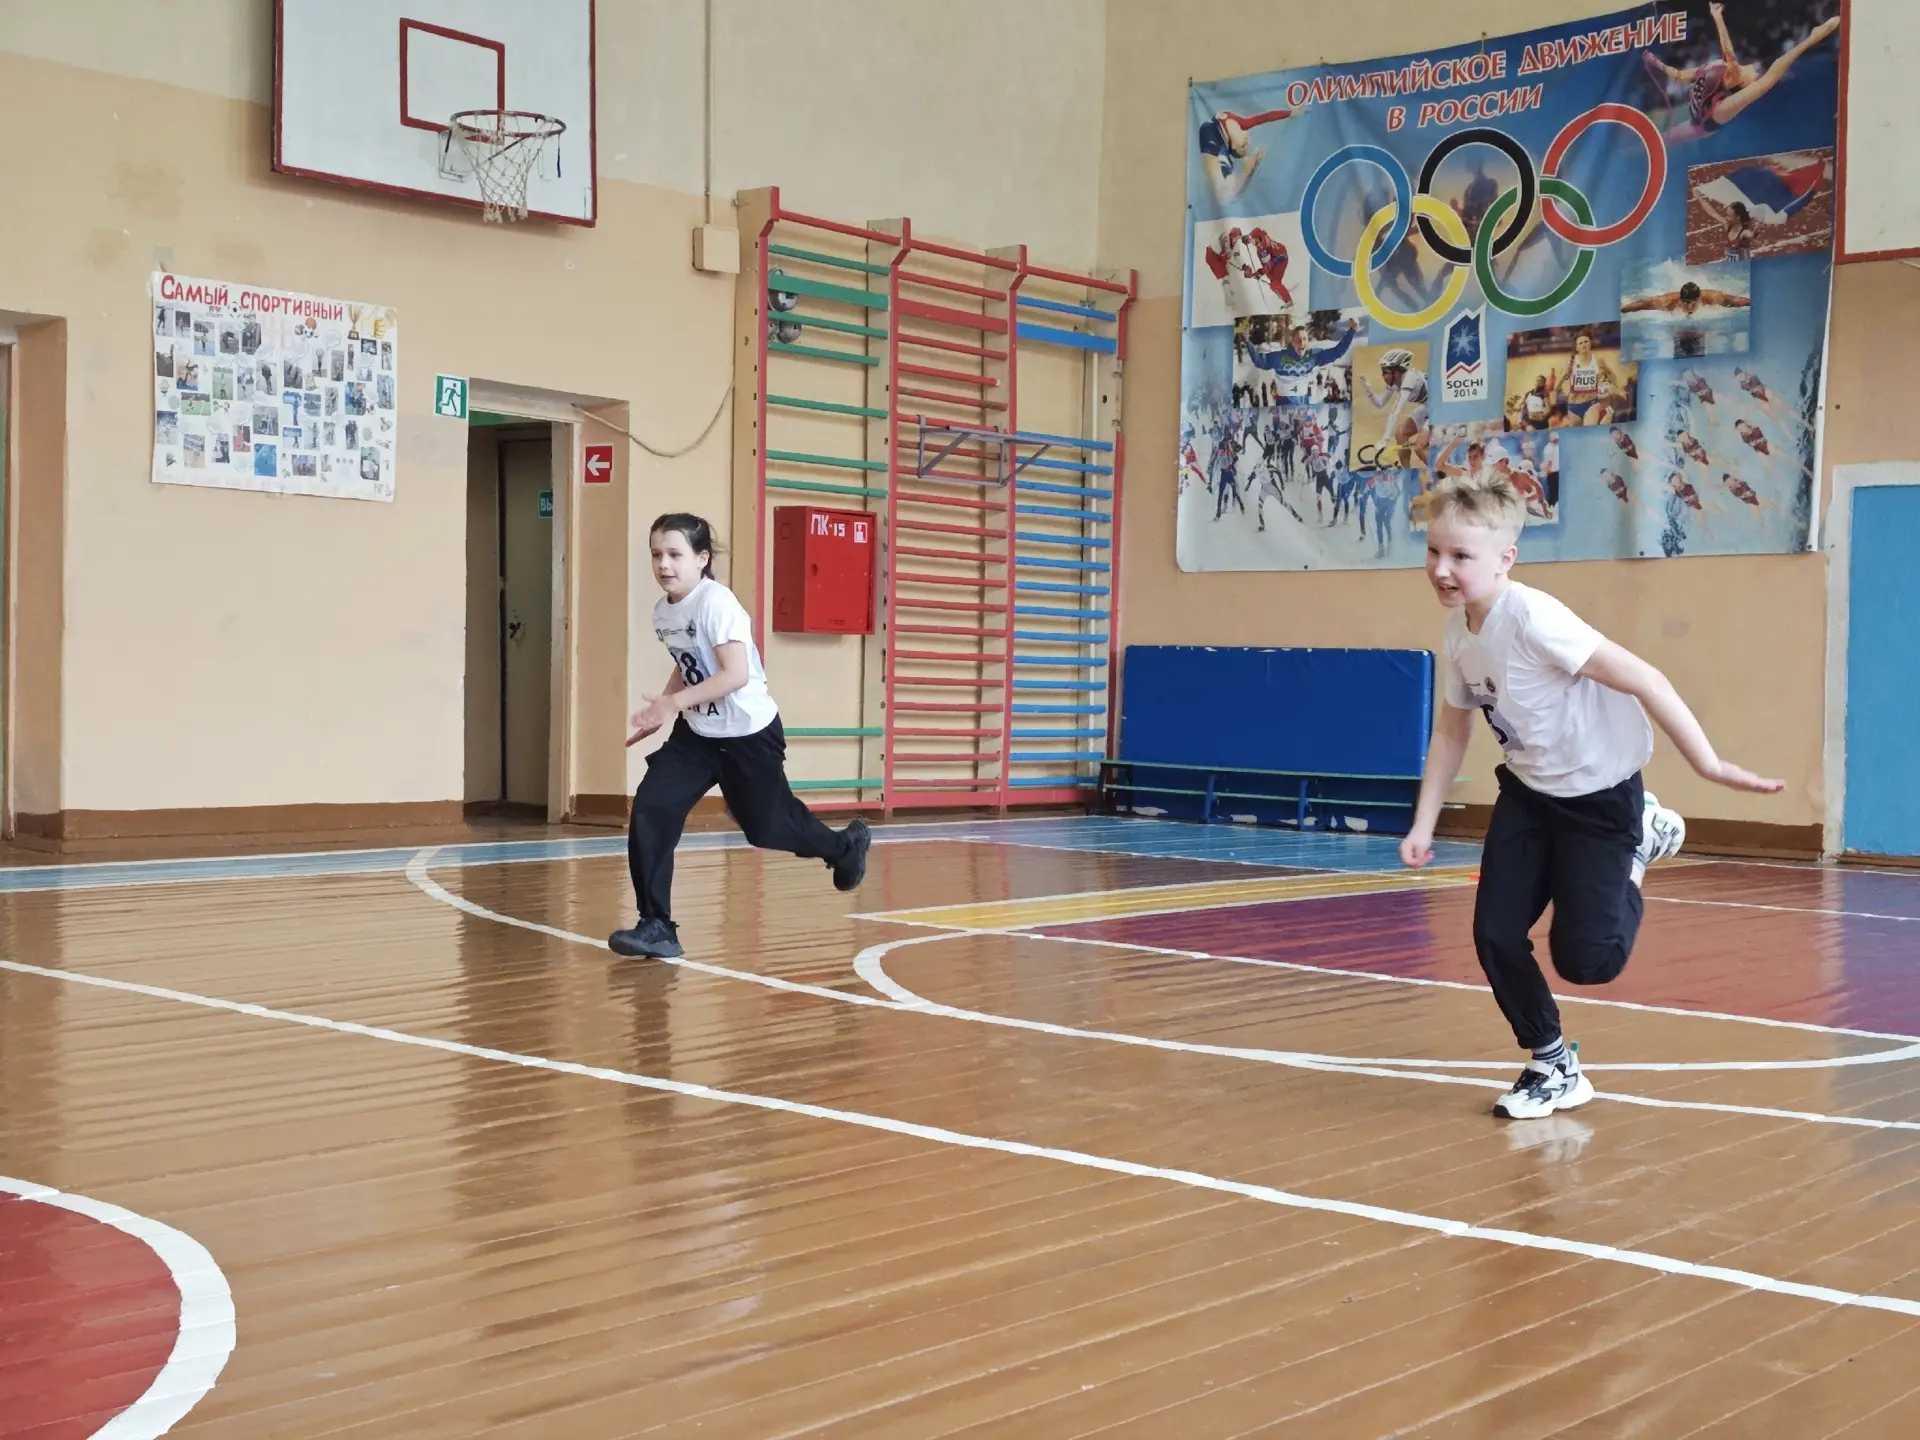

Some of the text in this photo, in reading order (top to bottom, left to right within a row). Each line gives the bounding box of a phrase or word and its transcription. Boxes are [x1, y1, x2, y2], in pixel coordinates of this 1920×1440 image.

[1286, 11, 1688, 107] ОЛИМПИЙСКОЕ ДВИЖЕНИЕ
[1386, 83, 1544, 131] В РОССИИ
[1446, 378, 1483, 389] SOCHI
[1575, 376, 1596, 386] RUS
[1454, 388, 1478, 397] 2014
